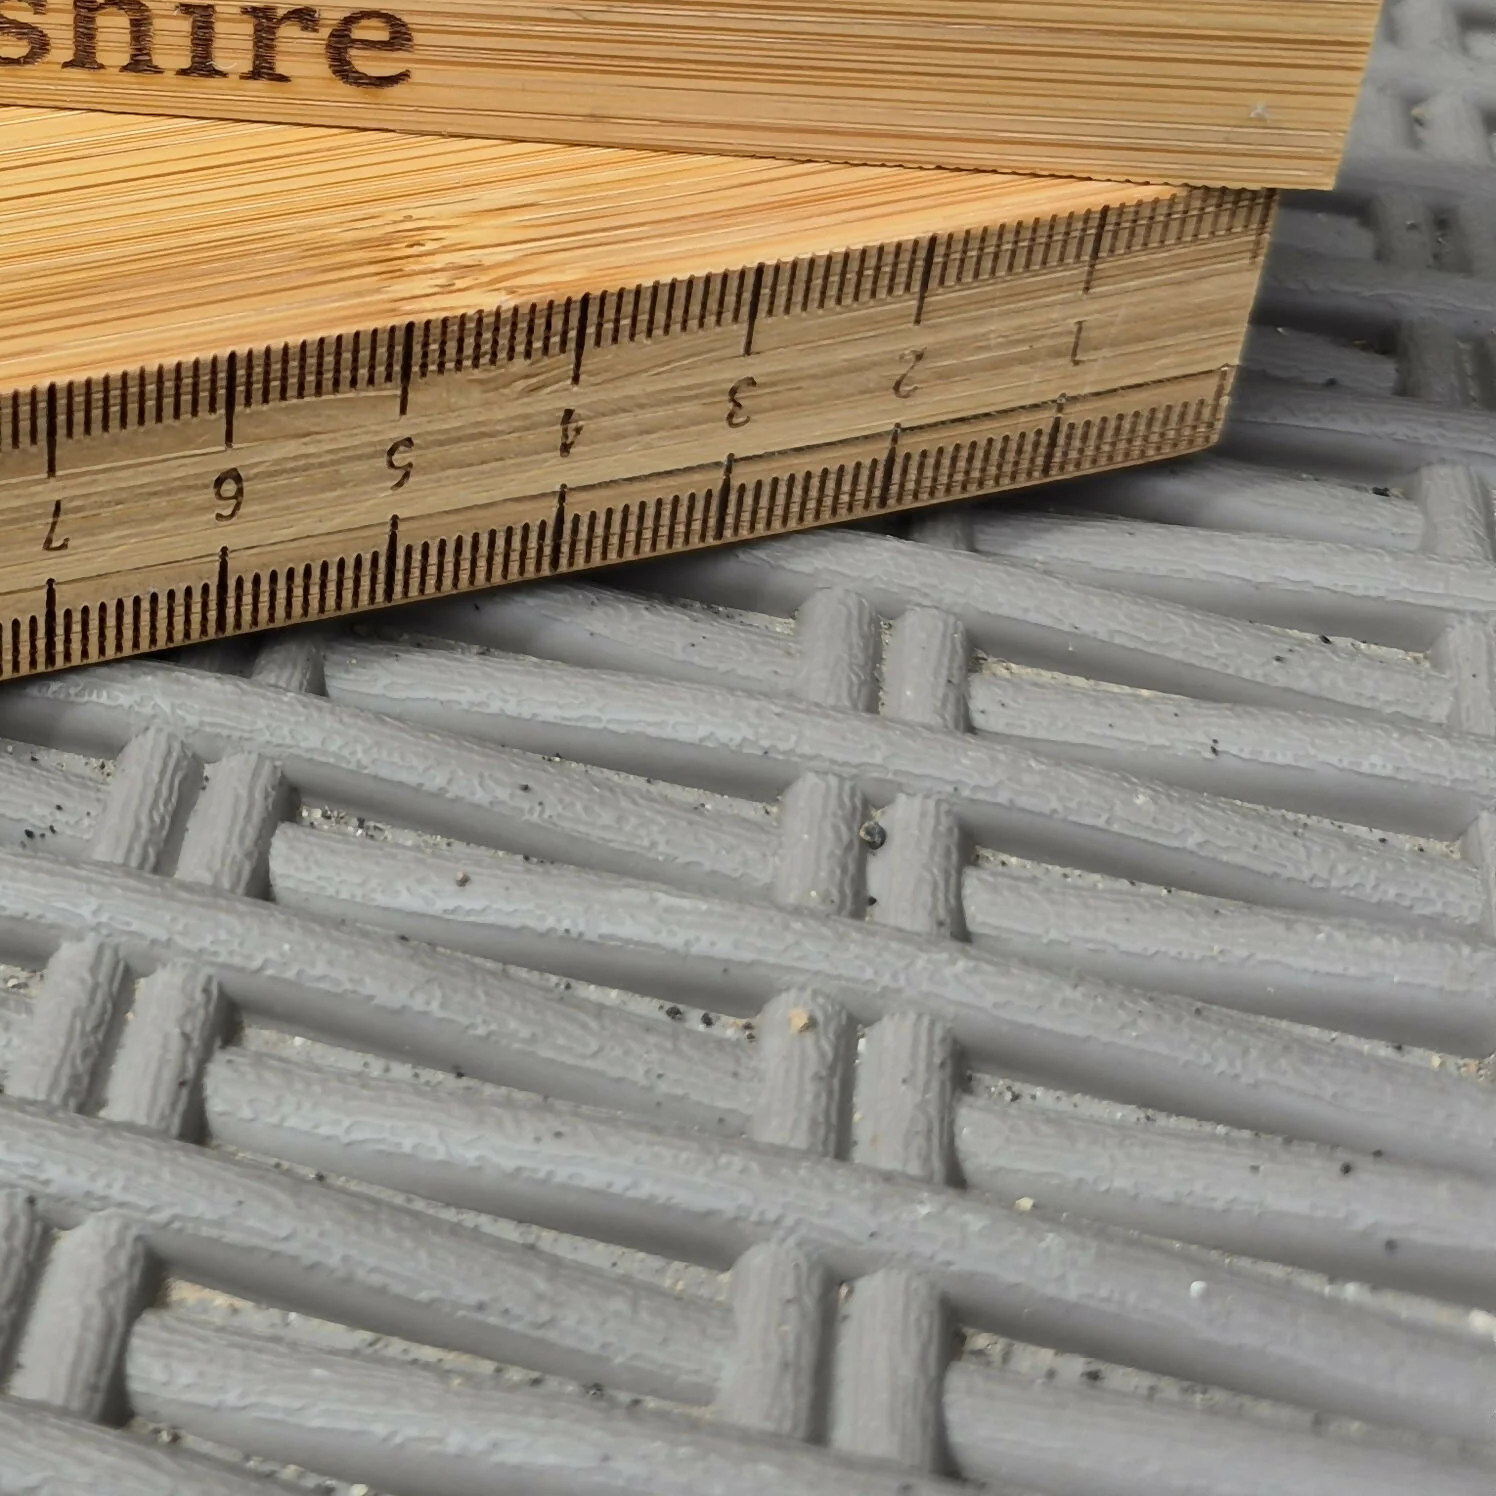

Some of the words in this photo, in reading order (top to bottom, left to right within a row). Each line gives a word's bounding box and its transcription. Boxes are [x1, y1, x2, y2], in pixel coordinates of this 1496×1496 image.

[1068, 319, 1088, 366] 1
[892, 345, 925, 399] 2
[725, 374, 758, 429] 3
[559, 407, 584, 458] 4
[385, 435, 415, 491] 5
[212, 466, 244, 522] 6
[42, 498, 70, 552] 7
